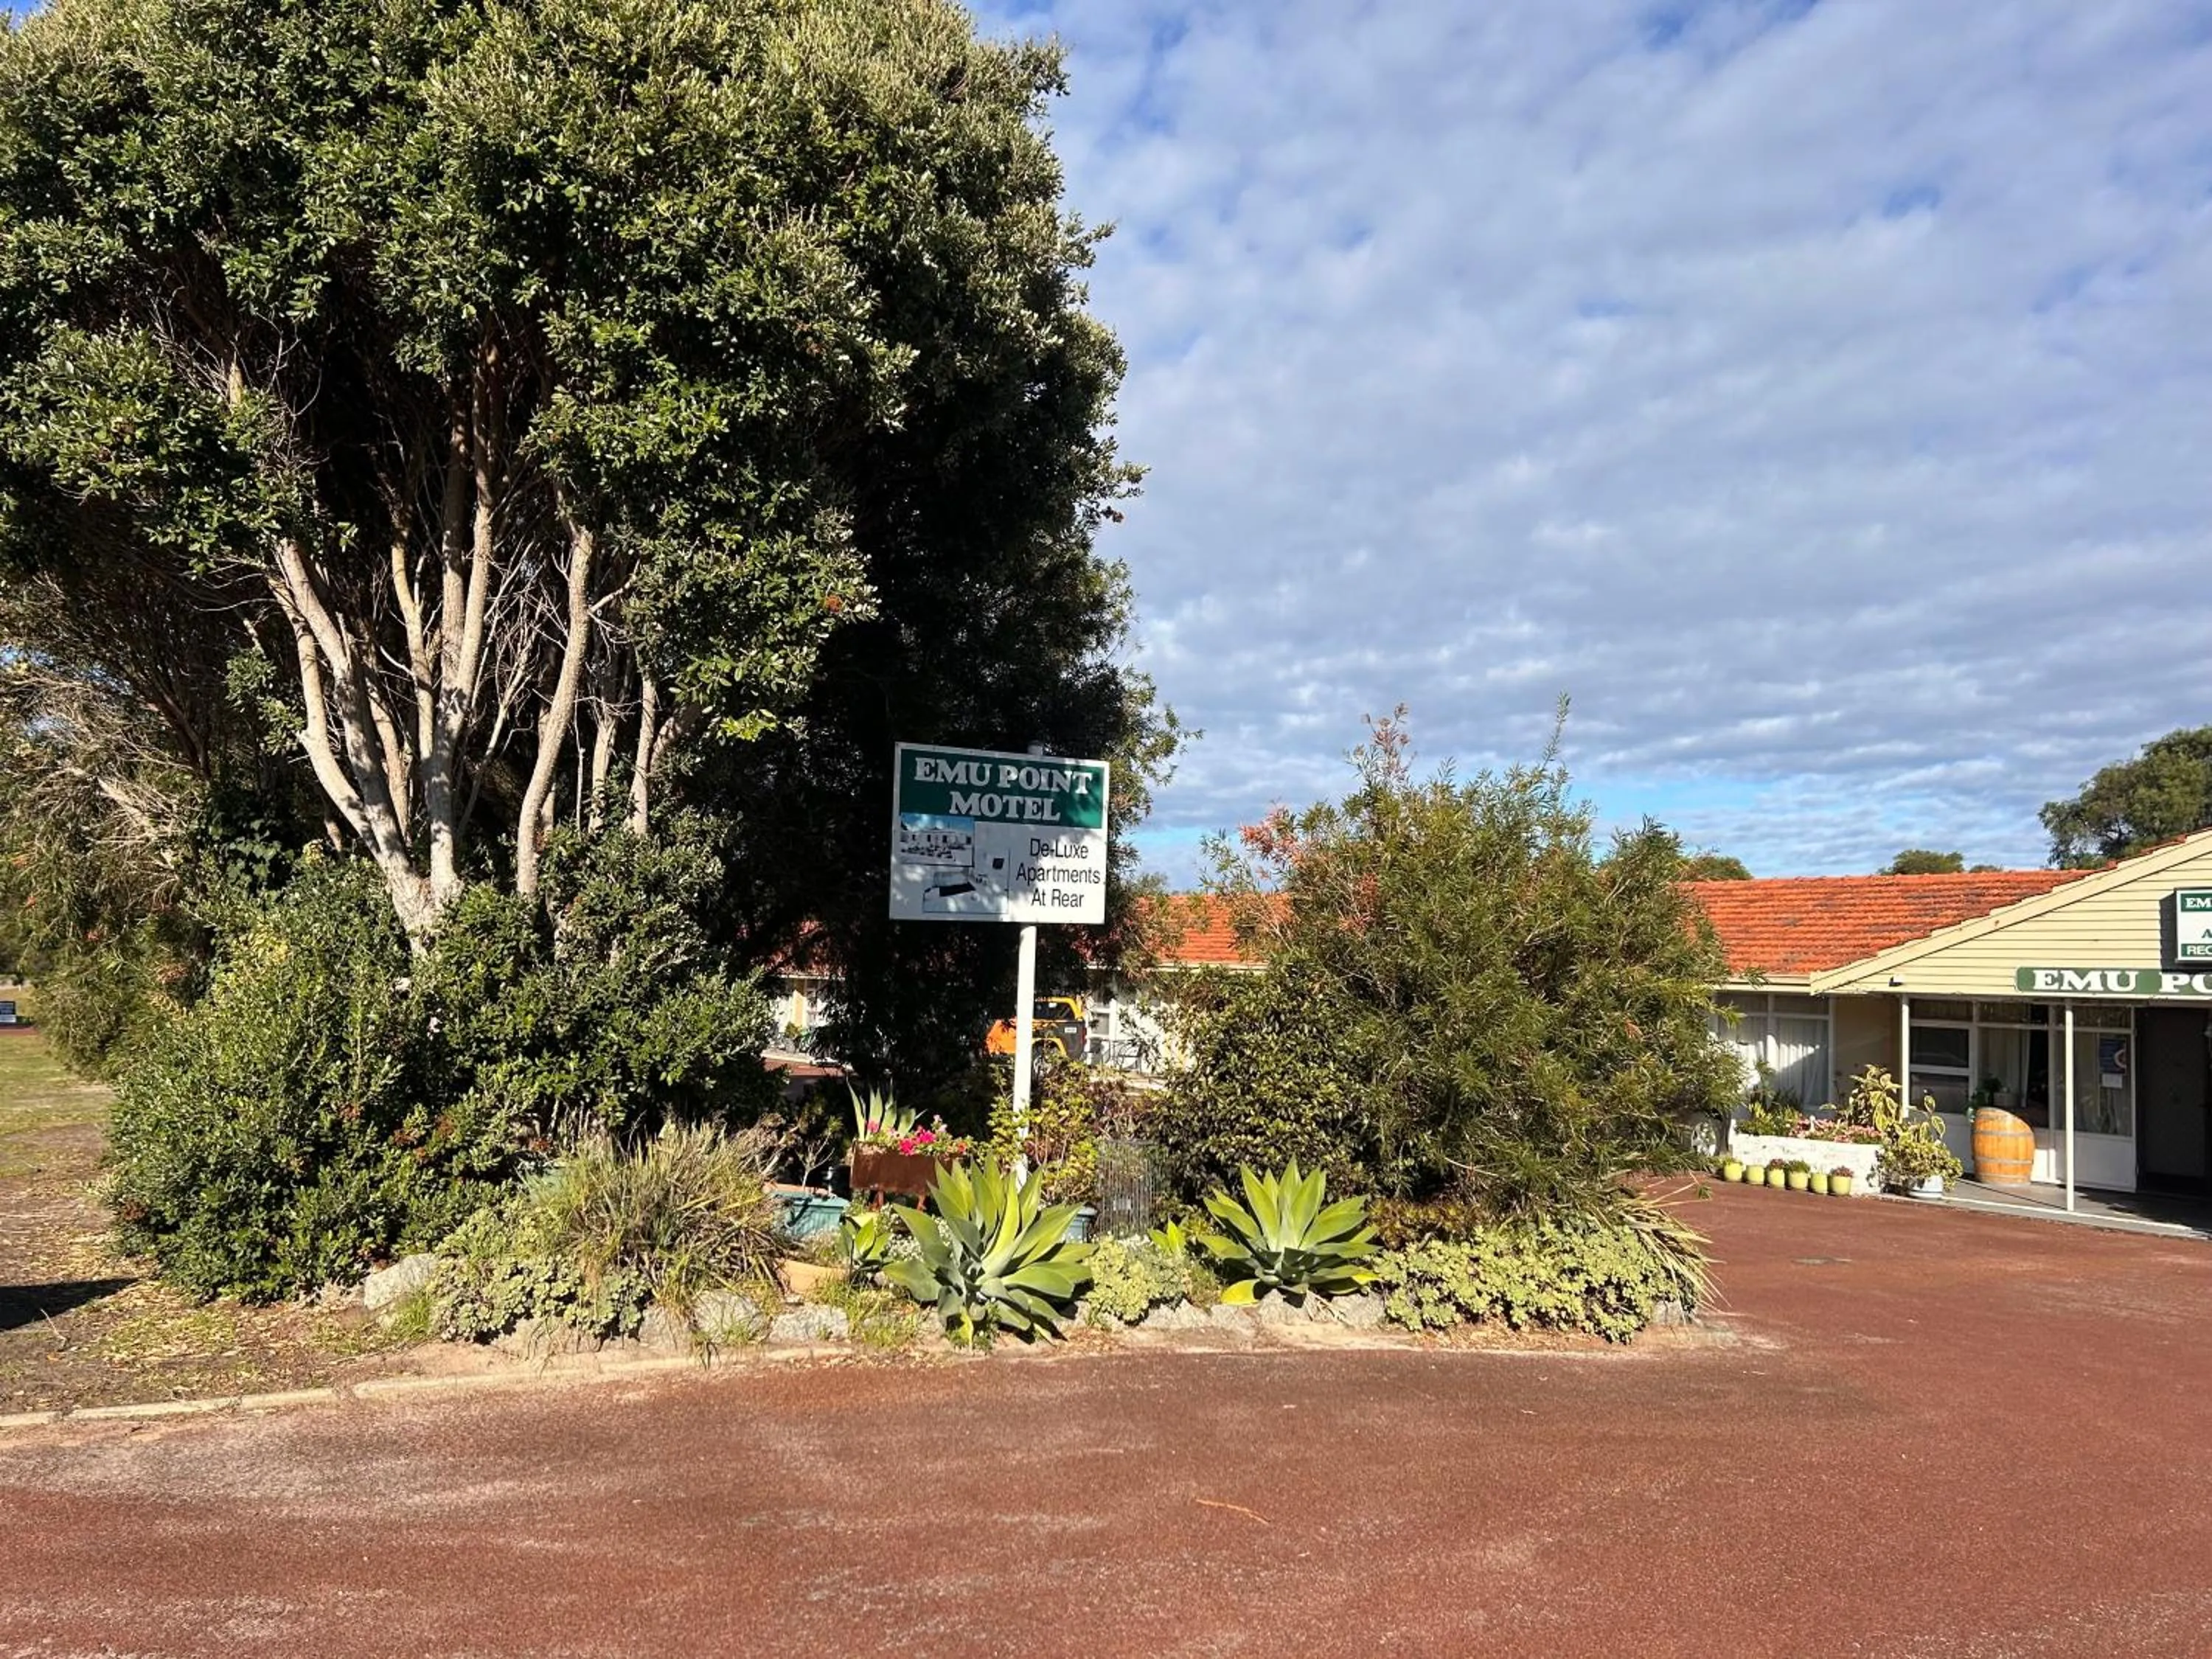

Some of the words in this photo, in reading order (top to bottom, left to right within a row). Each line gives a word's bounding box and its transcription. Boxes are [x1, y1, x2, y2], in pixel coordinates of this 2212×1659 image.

[914, 757, 992, 786] EMU
[997, 766, 1093, 794] POINT
[949, 791, 1061, 821] MOTEL
[1030, 838, 1089, 859] De-Luxe
[1016, 863, 1101, 886] Apartments
[1031, 888, 1046, 906] At
[1051, 888, 1085, 908] Rear
[2033, 970, 2139, 992] EMU
